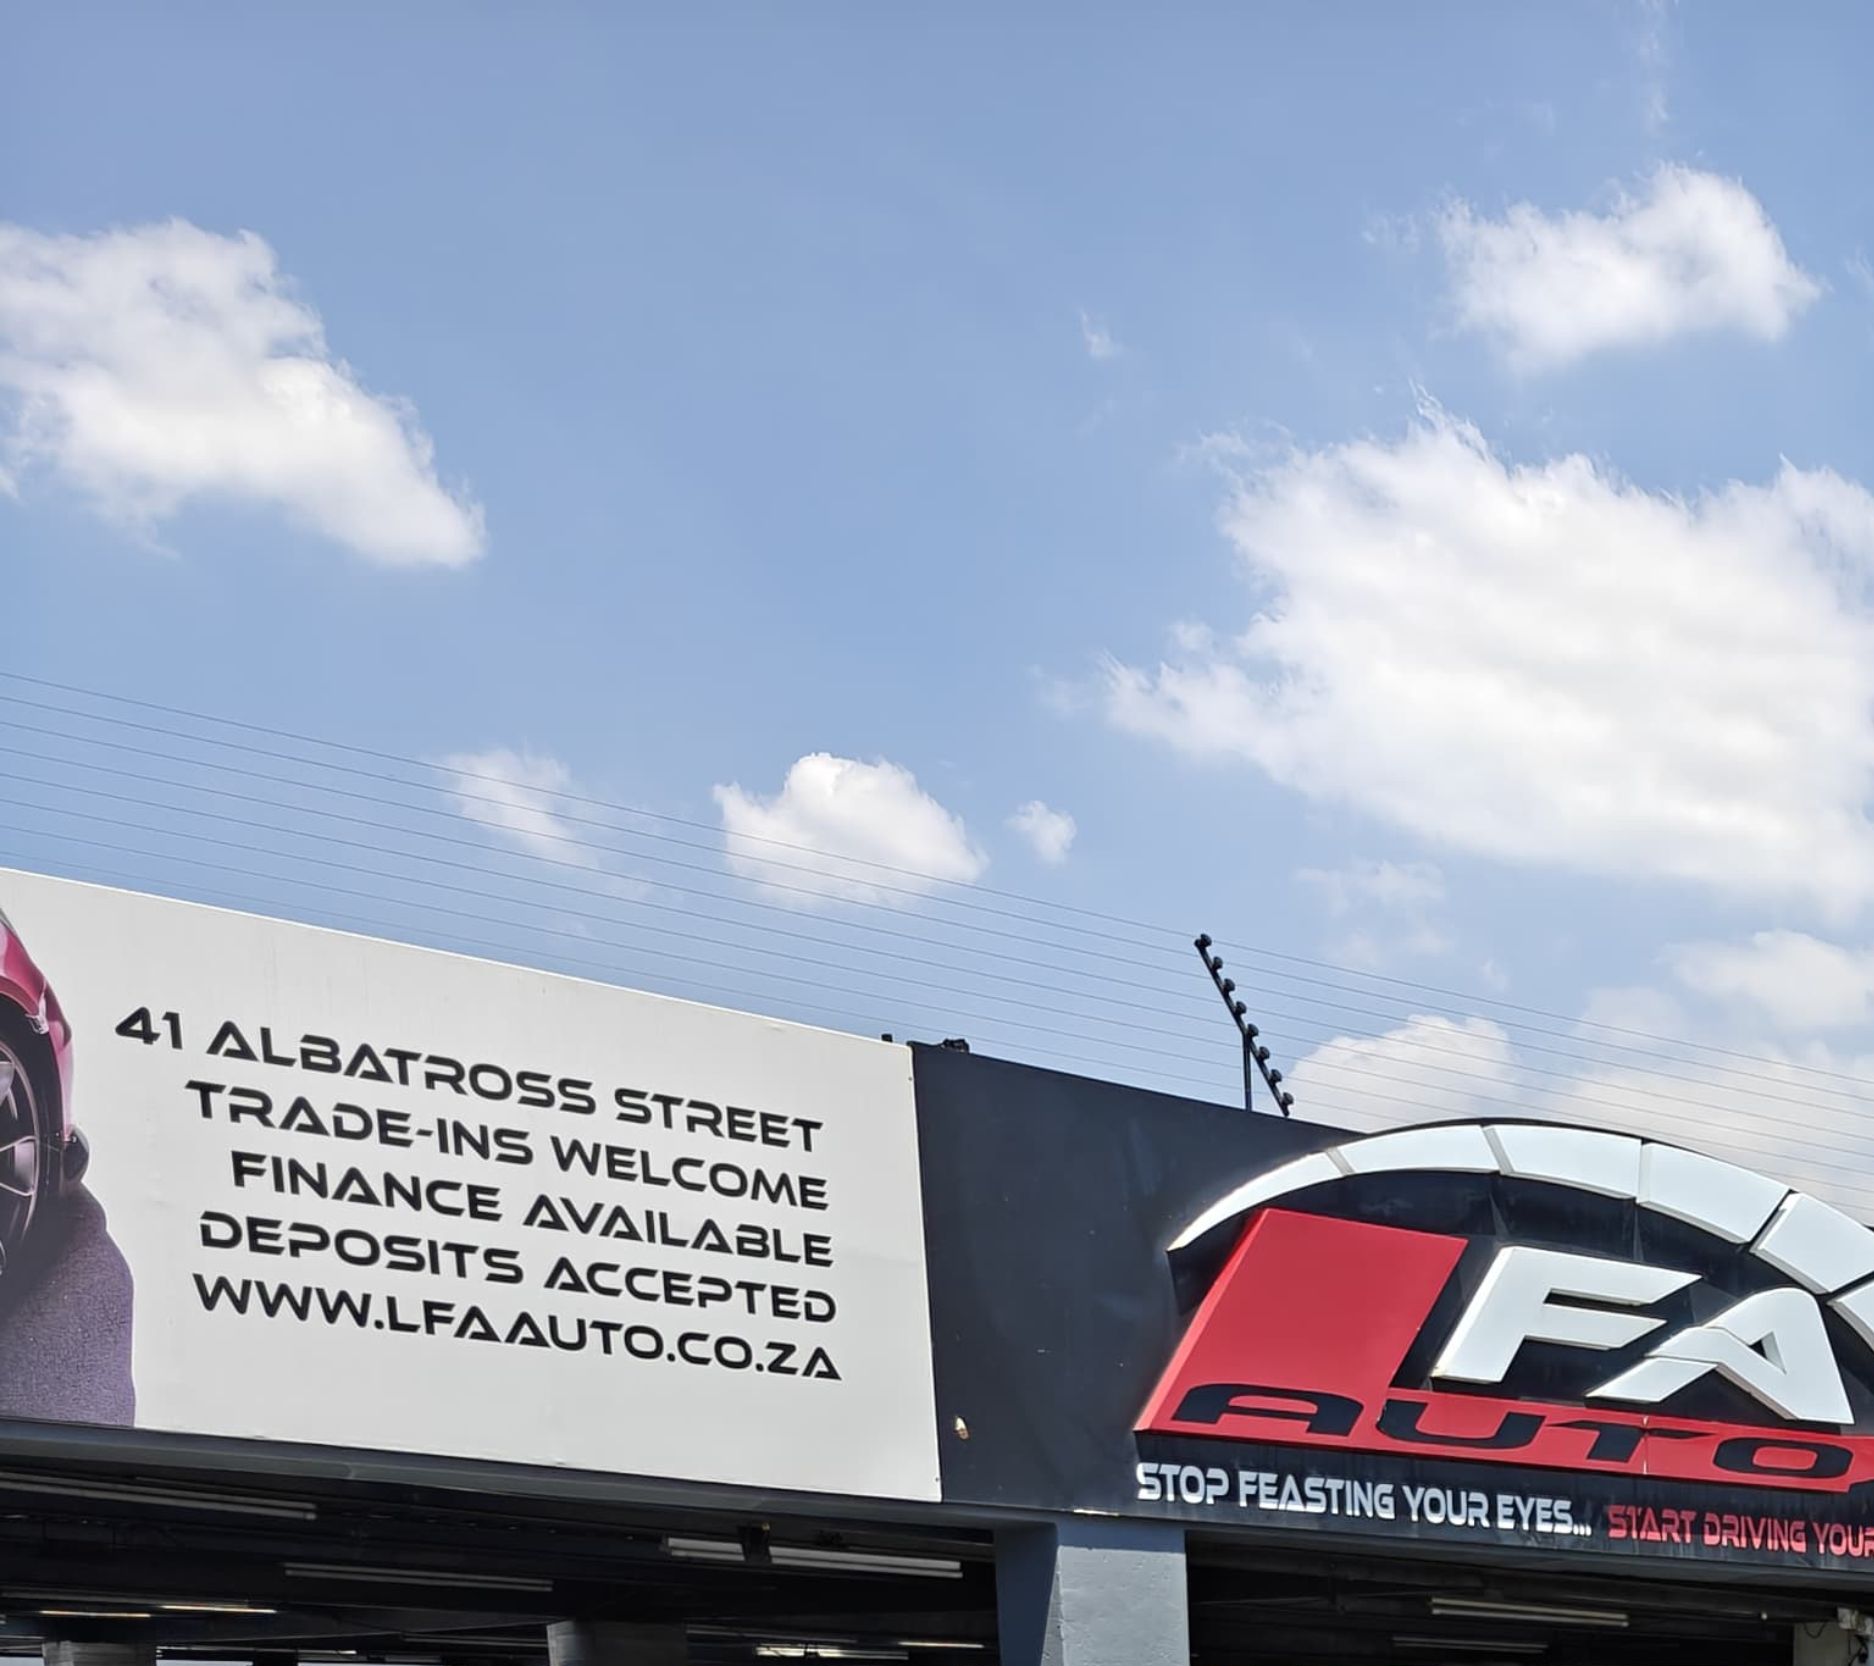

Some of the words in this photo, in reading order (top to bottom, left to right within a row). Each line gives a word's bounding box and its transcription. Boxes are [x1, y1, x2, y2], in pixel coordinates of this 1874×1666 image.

[115, 1007, 182, 1049] 41
[206, 1021, 596, 1115] ALBATROSS
[614, 1088, 823, 1153] STREET
[185, 1080, 533, 1165] TRADE-INS
[550, 1135, 828, 1211] WELCOME
[200, 1210, 524, 1284] DEPOSITS
[544, 1256, 836, 1323] ACCEPTED
[231, 1150, 502, 1222] FINANCE
[523, 1194, 833, 1268] AVAILABLE
[192, 1273, 842, 1381] WWW.LFAAUTO.CO.ZA
[1136, 1208, 1854, 1434] LFA
[1172, 1382, 1854, 1480] AUTO
[1136, 1462, 1230, 1504] STOP
[1238, 1470, 1395, 1520] FEASTING
[1402, 1484, 1490, 1528] YOUR
[1497, 1493, 1592, 1536] EYES...
[1607, 1504, 1697, 1544] START
[1703, 1512, 1806, 1553] DRIVING
